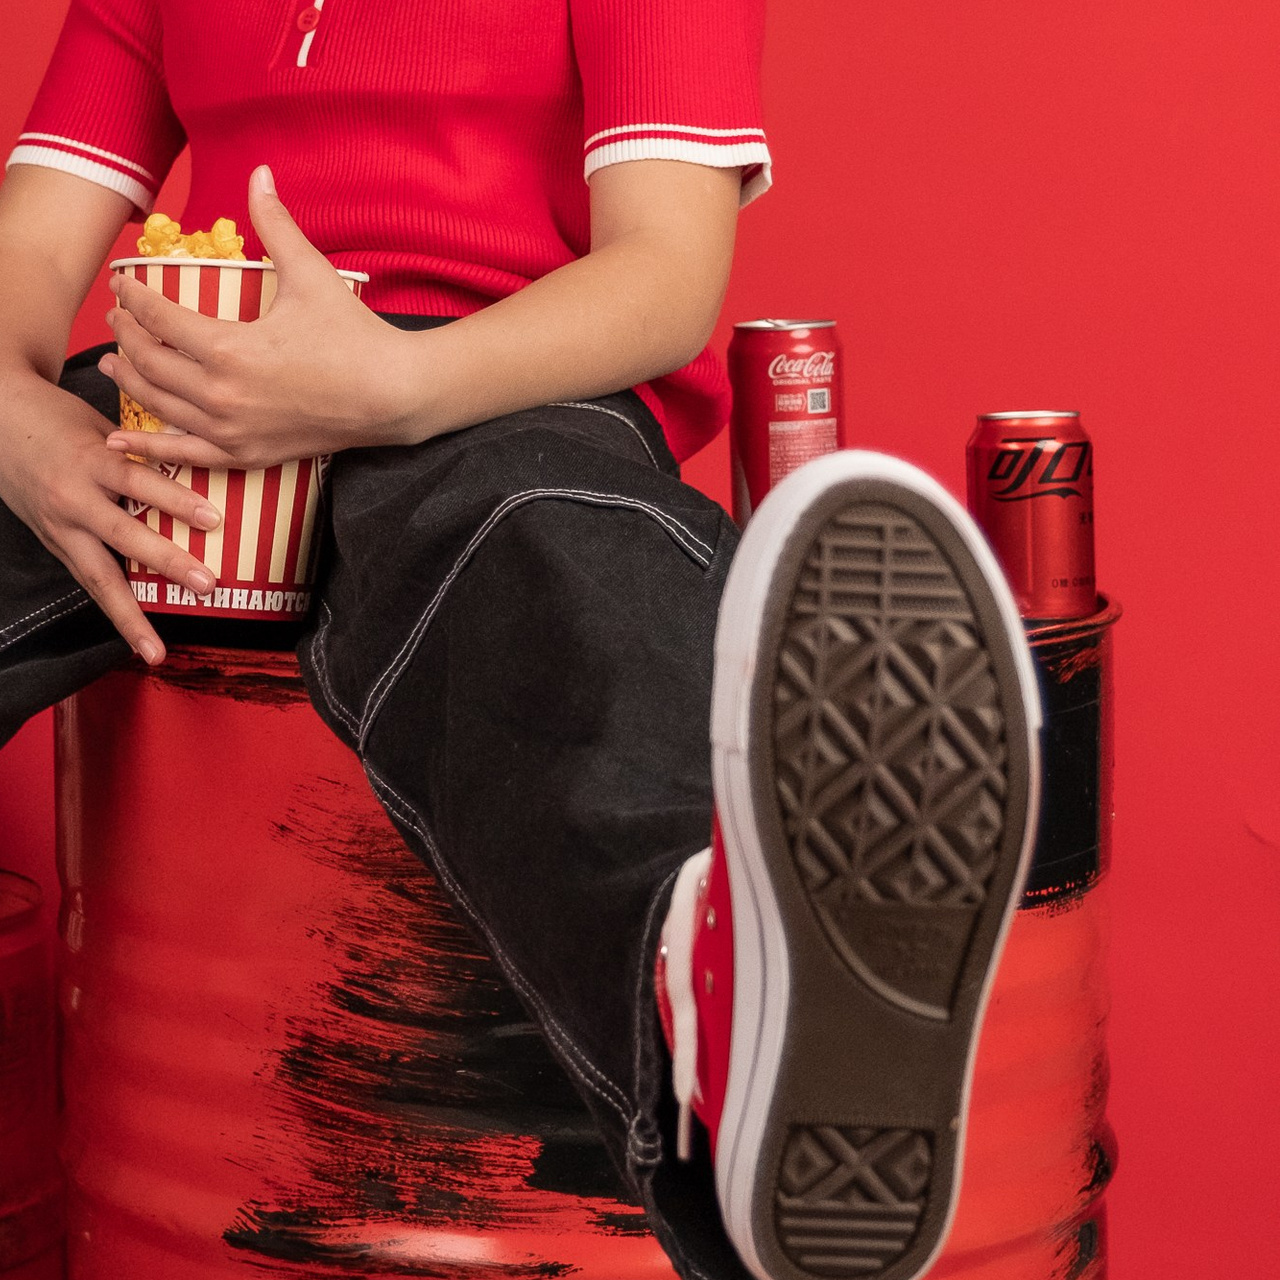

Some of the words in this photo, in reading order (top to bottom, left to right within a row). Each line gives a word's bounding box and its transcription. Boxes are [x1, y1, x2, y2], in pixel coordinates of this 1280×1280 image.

[768, 351, 835, 379] Coca-Cola
[772, 378, 811, 386] ORIGINAL
[812, 376, 832, 384] TASTE
[987, 437, 1092, 495] 可口
